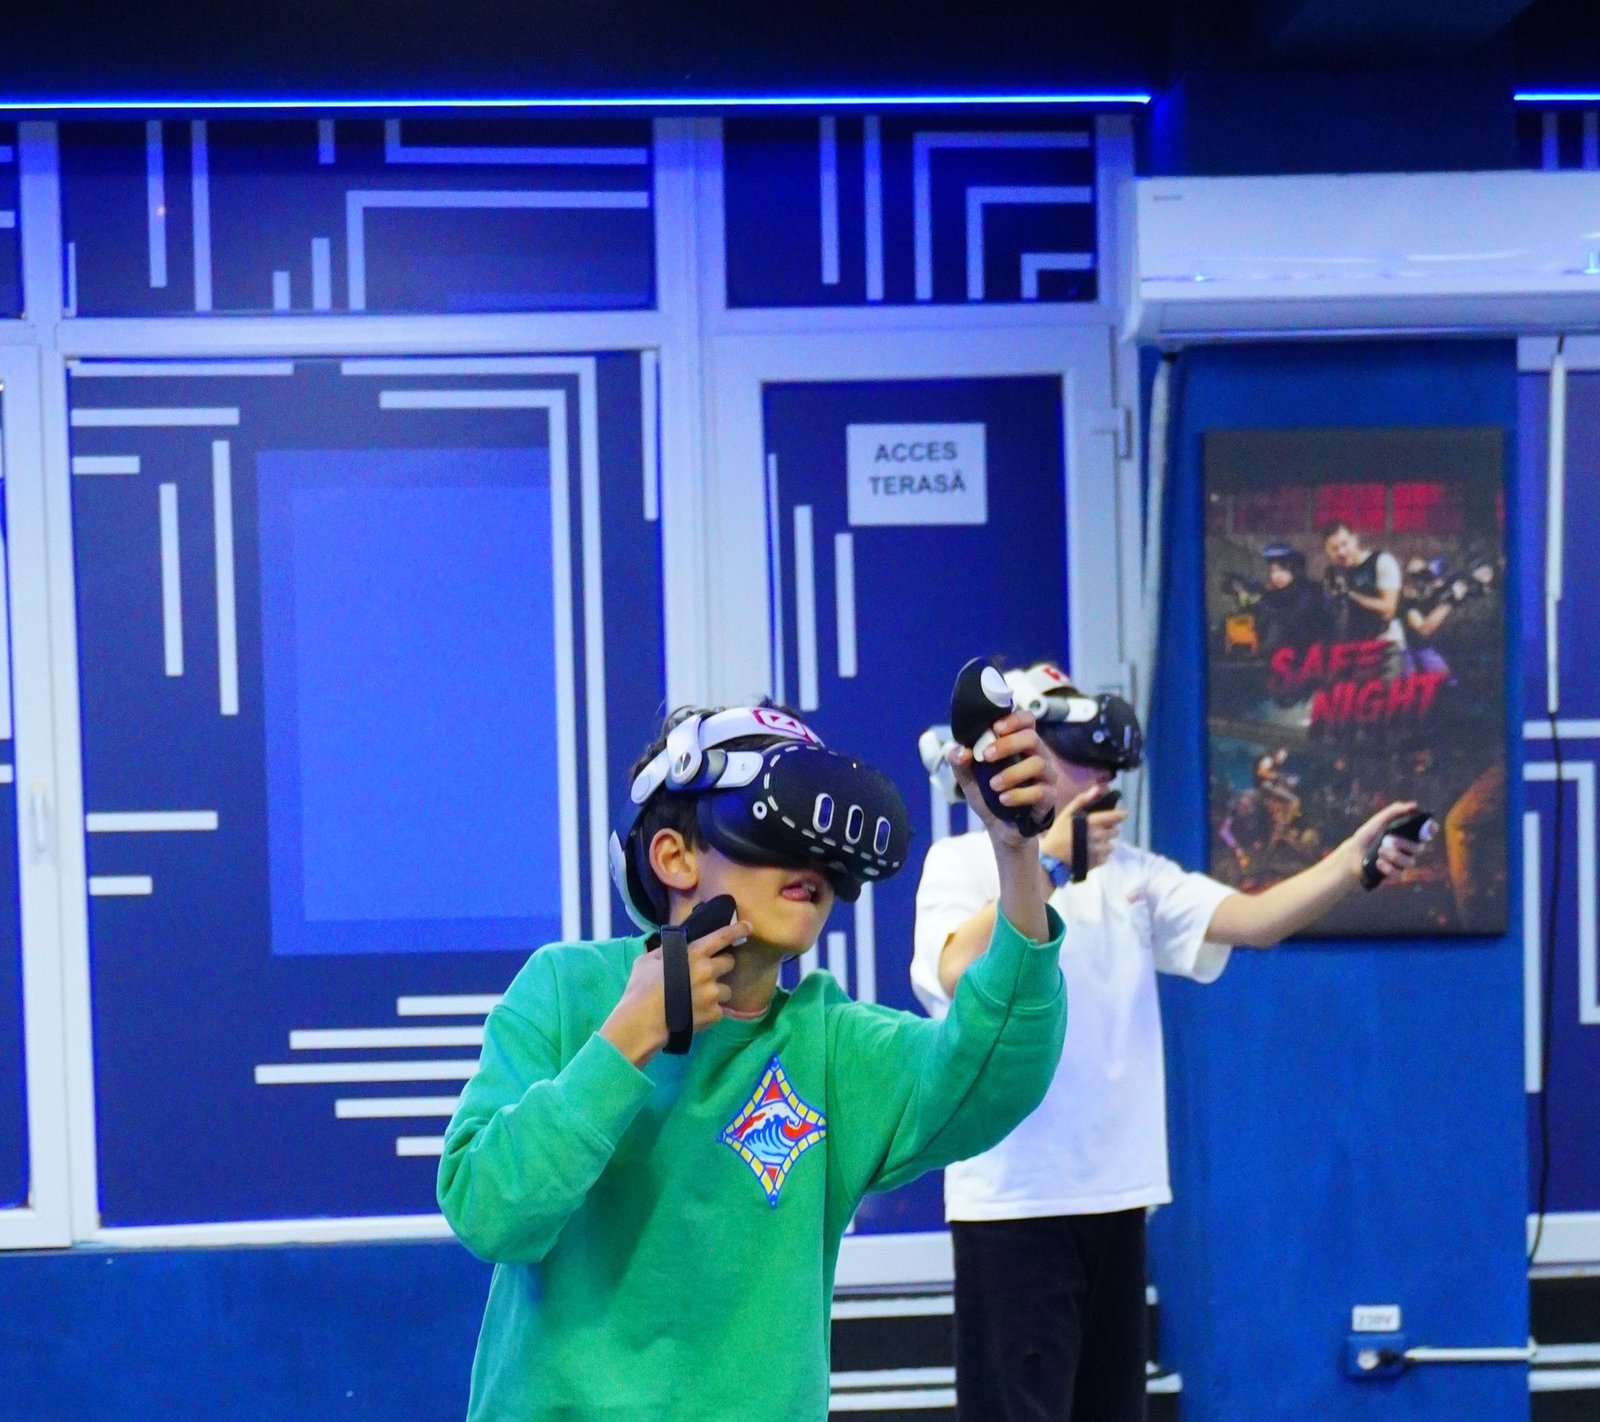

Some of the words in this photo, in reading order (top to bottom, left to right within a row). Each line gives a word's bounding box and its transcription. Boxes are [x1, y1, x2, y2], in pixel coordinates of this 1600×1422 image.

[874, 441, 959, 463] ACCES
[1268, 638, 1389, 690] SAFE
[1311, 671, 1446, 725] NIGHT
